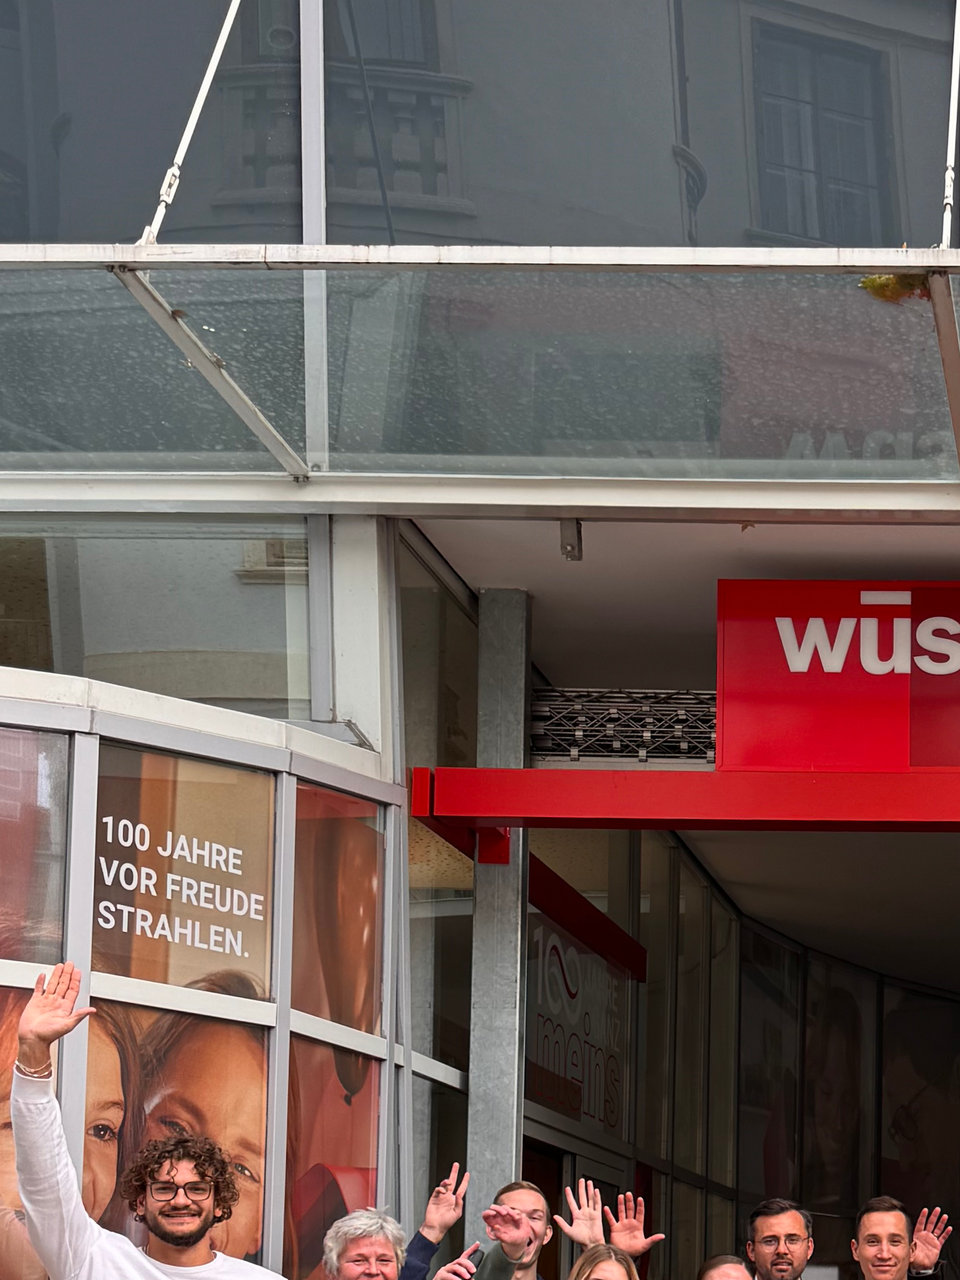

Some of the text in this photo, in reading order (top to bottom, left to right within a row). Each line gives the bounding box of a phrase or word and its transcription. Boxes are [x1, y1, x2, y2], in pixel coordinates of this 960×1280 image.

[102, 816, 243, 876] 100 JAHRE
[99, 857, 264, 921] VOR FREUDE
[97, 901, 250, 958] STRAHLEN.
[537, 1012, 620, 1128] meins
